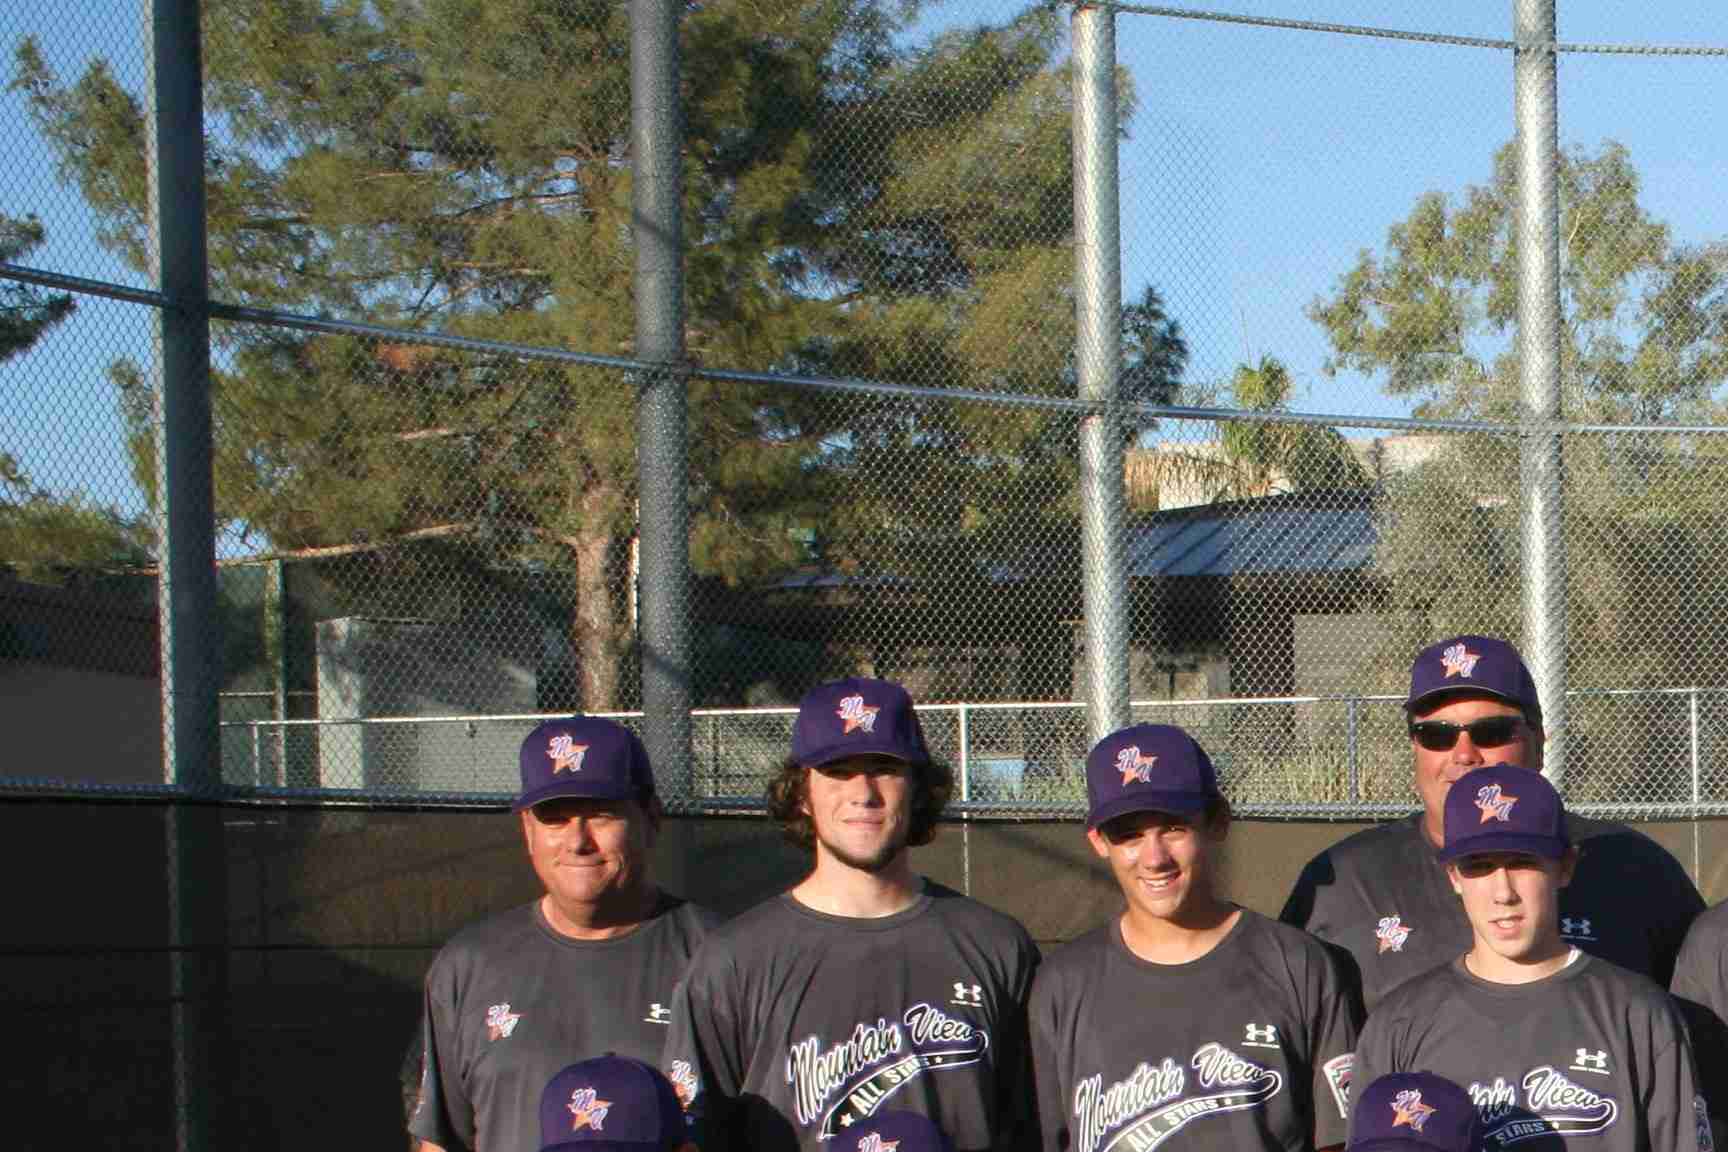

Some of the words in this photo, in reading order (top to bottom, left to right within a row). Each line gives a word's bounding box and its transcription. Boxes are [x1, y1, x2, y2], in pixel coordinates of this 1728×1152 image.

[788, 1018, 901, 1124] Mountain
[904, 1003, 976, 1045] View
[1191, 1042, 1265, 1087] View
[849, 1080, 885, 1115] ALL
[1523, 1067, 1599, 1111] View
[1164, 1099, 1218, 1125] STARS
